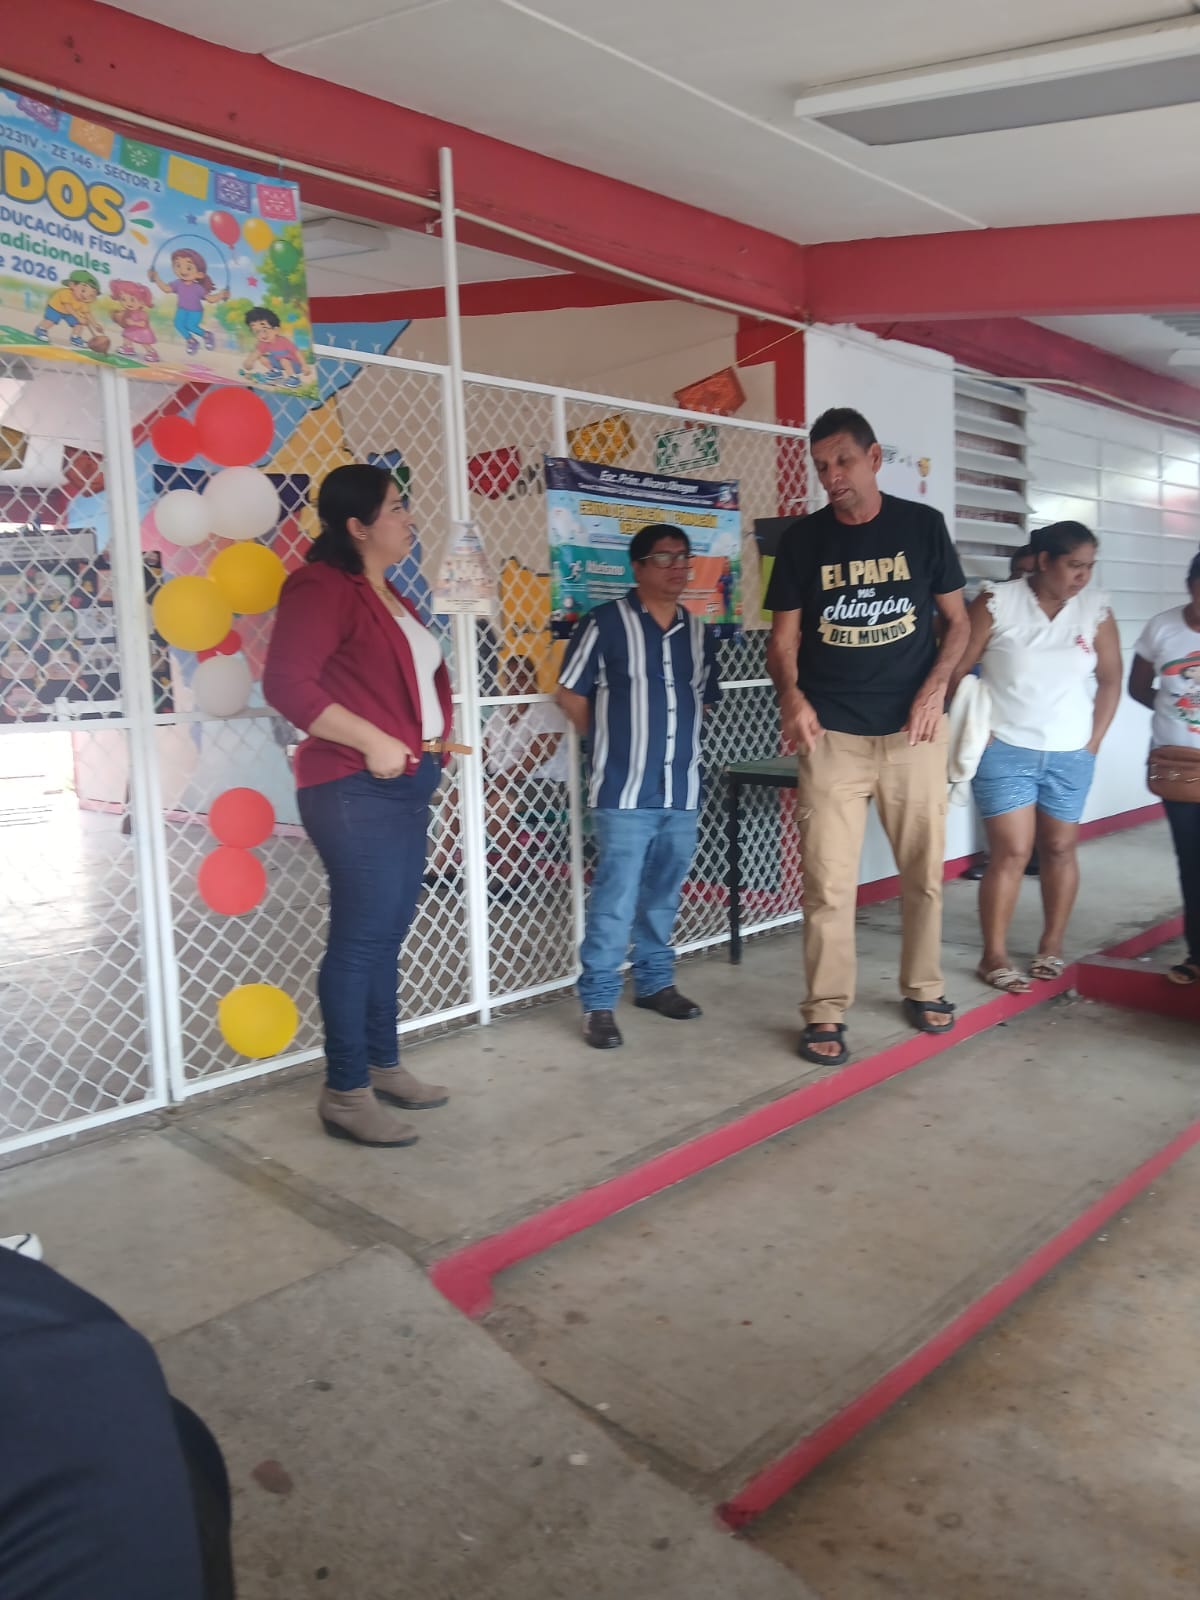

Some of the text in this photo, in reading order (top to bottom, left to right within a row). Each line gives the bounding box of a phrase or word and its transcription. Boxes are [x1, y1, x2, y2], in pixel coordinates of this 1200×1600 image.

[51, 143, 67, 160] ZE
[71, 151, 92, 168] 146
[104, 164, 150, 190] SECTOR
[154, 181, 161, 193] 2
[0, 145, 125, 236] DOS
[89, 234, 137, 264] FÍSICA
[11, 256, 58, 282] 2026
[820, 550, 912, 591] EL PAPÁ
[822, 595, 913, 626] chingón
[829, 622, 907, 645] DEL MUNDO
